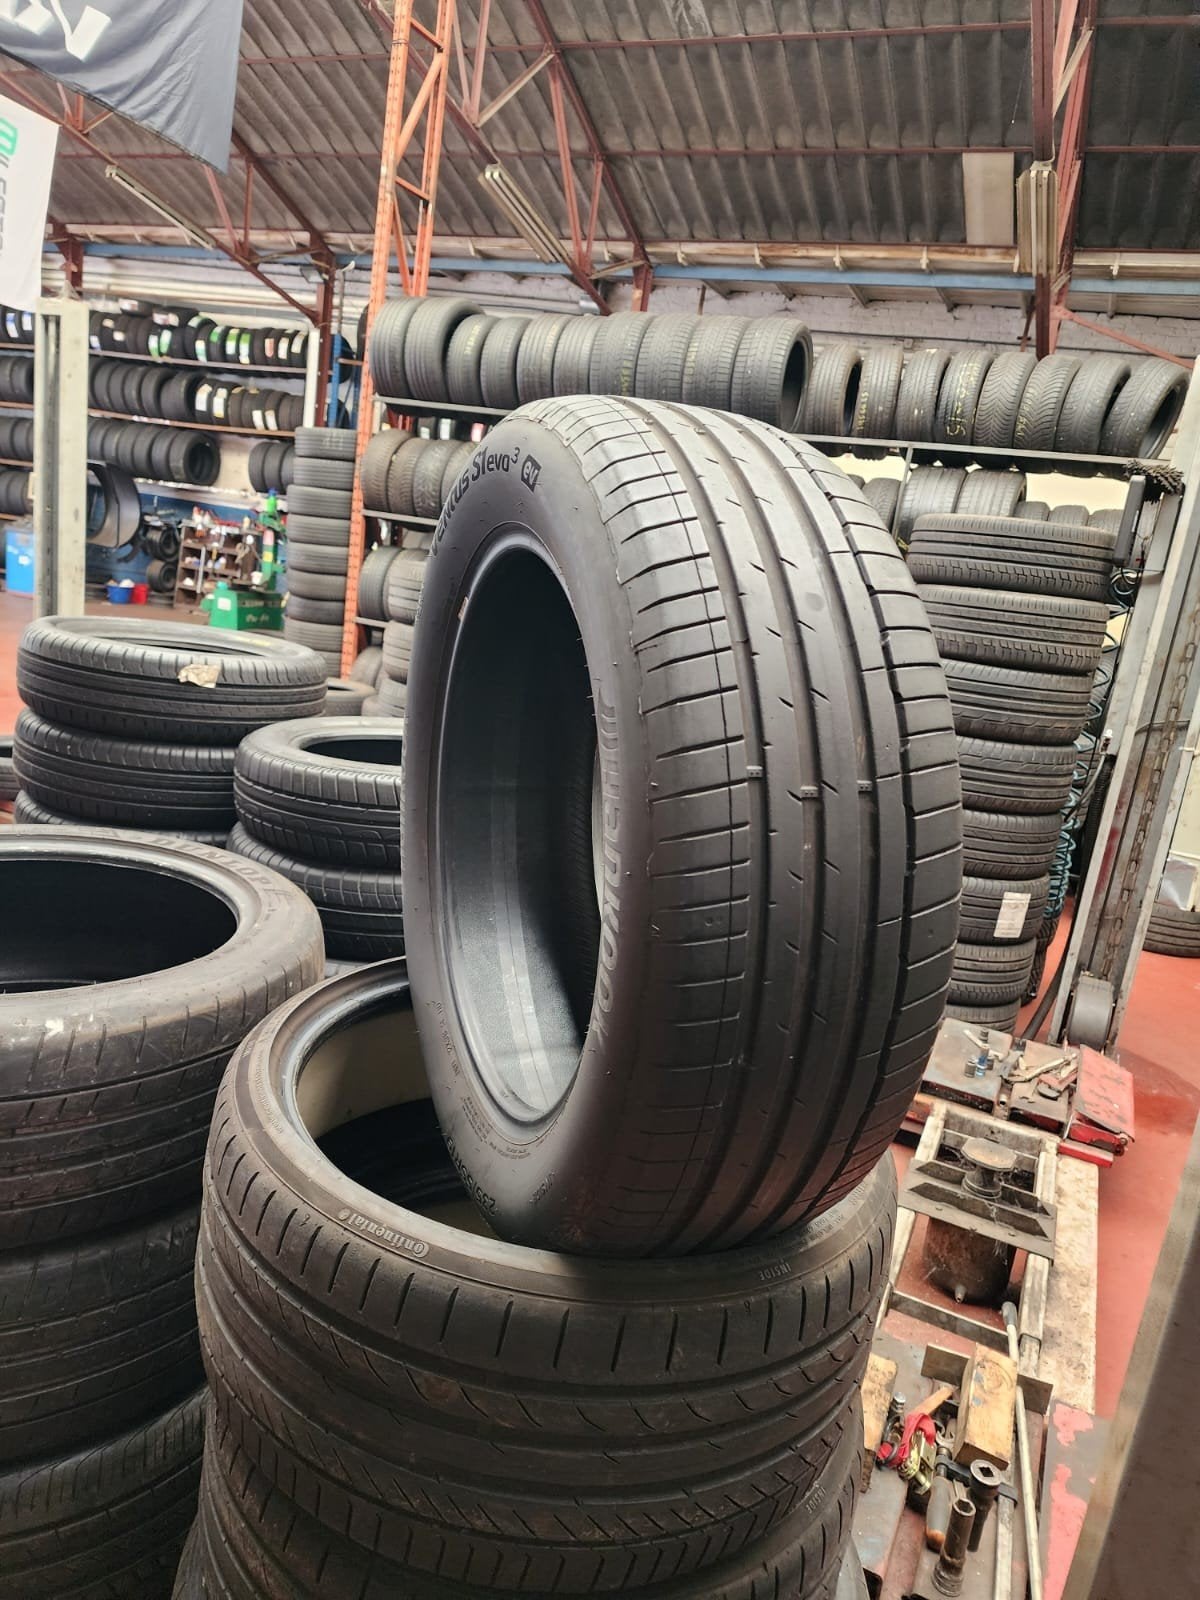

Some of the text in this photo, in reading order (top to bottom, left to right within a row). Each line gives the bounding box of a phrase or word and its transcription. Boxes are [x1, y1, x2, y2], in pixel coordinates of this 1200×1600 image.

[150, 837, 273, 886] DUNLOP
[347, 1213, 430, 1258] Continental
[759, 1263, 793, 1281] INSIDE
[805, 1487, 827, 1514] INSIDE
